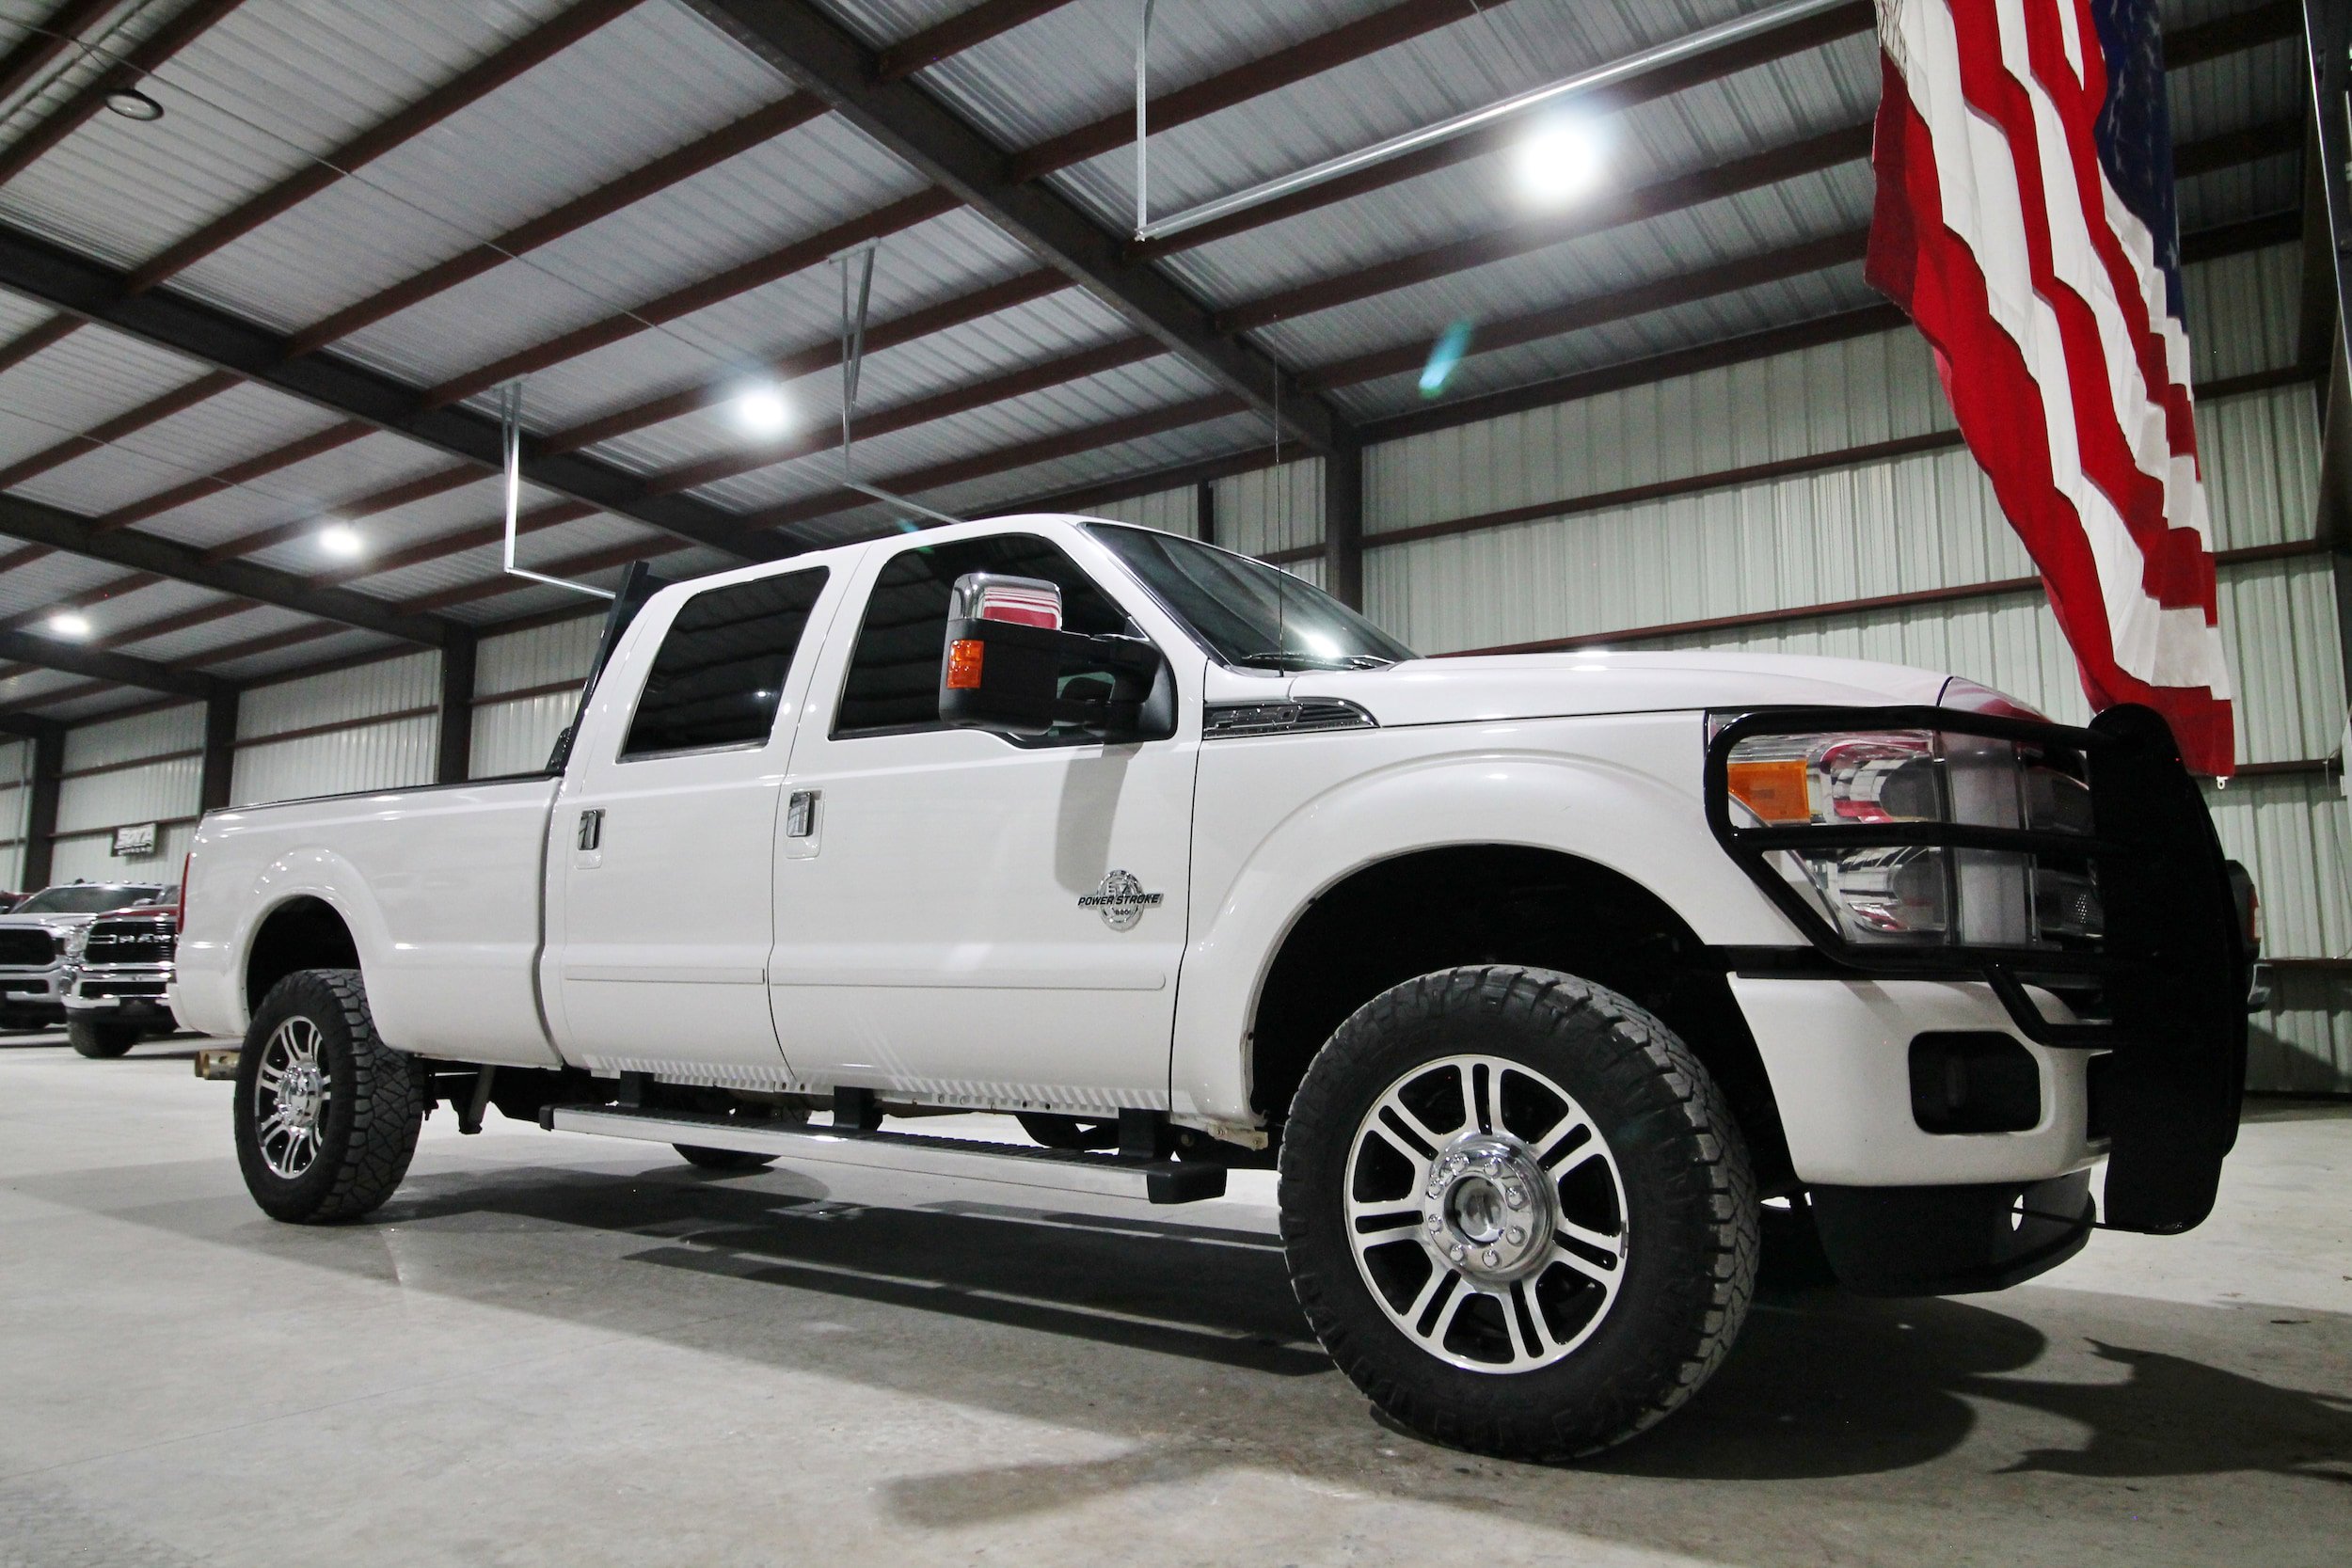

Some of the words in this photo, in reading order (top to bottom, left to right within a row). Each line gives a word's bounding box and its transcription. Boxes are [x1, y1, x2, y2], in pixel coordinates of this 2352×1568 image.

[1077, 895, 1115, 906] POWER
[1116, 894, 1161, 905] STROKE
[119, 933, 171, 943] RAM
